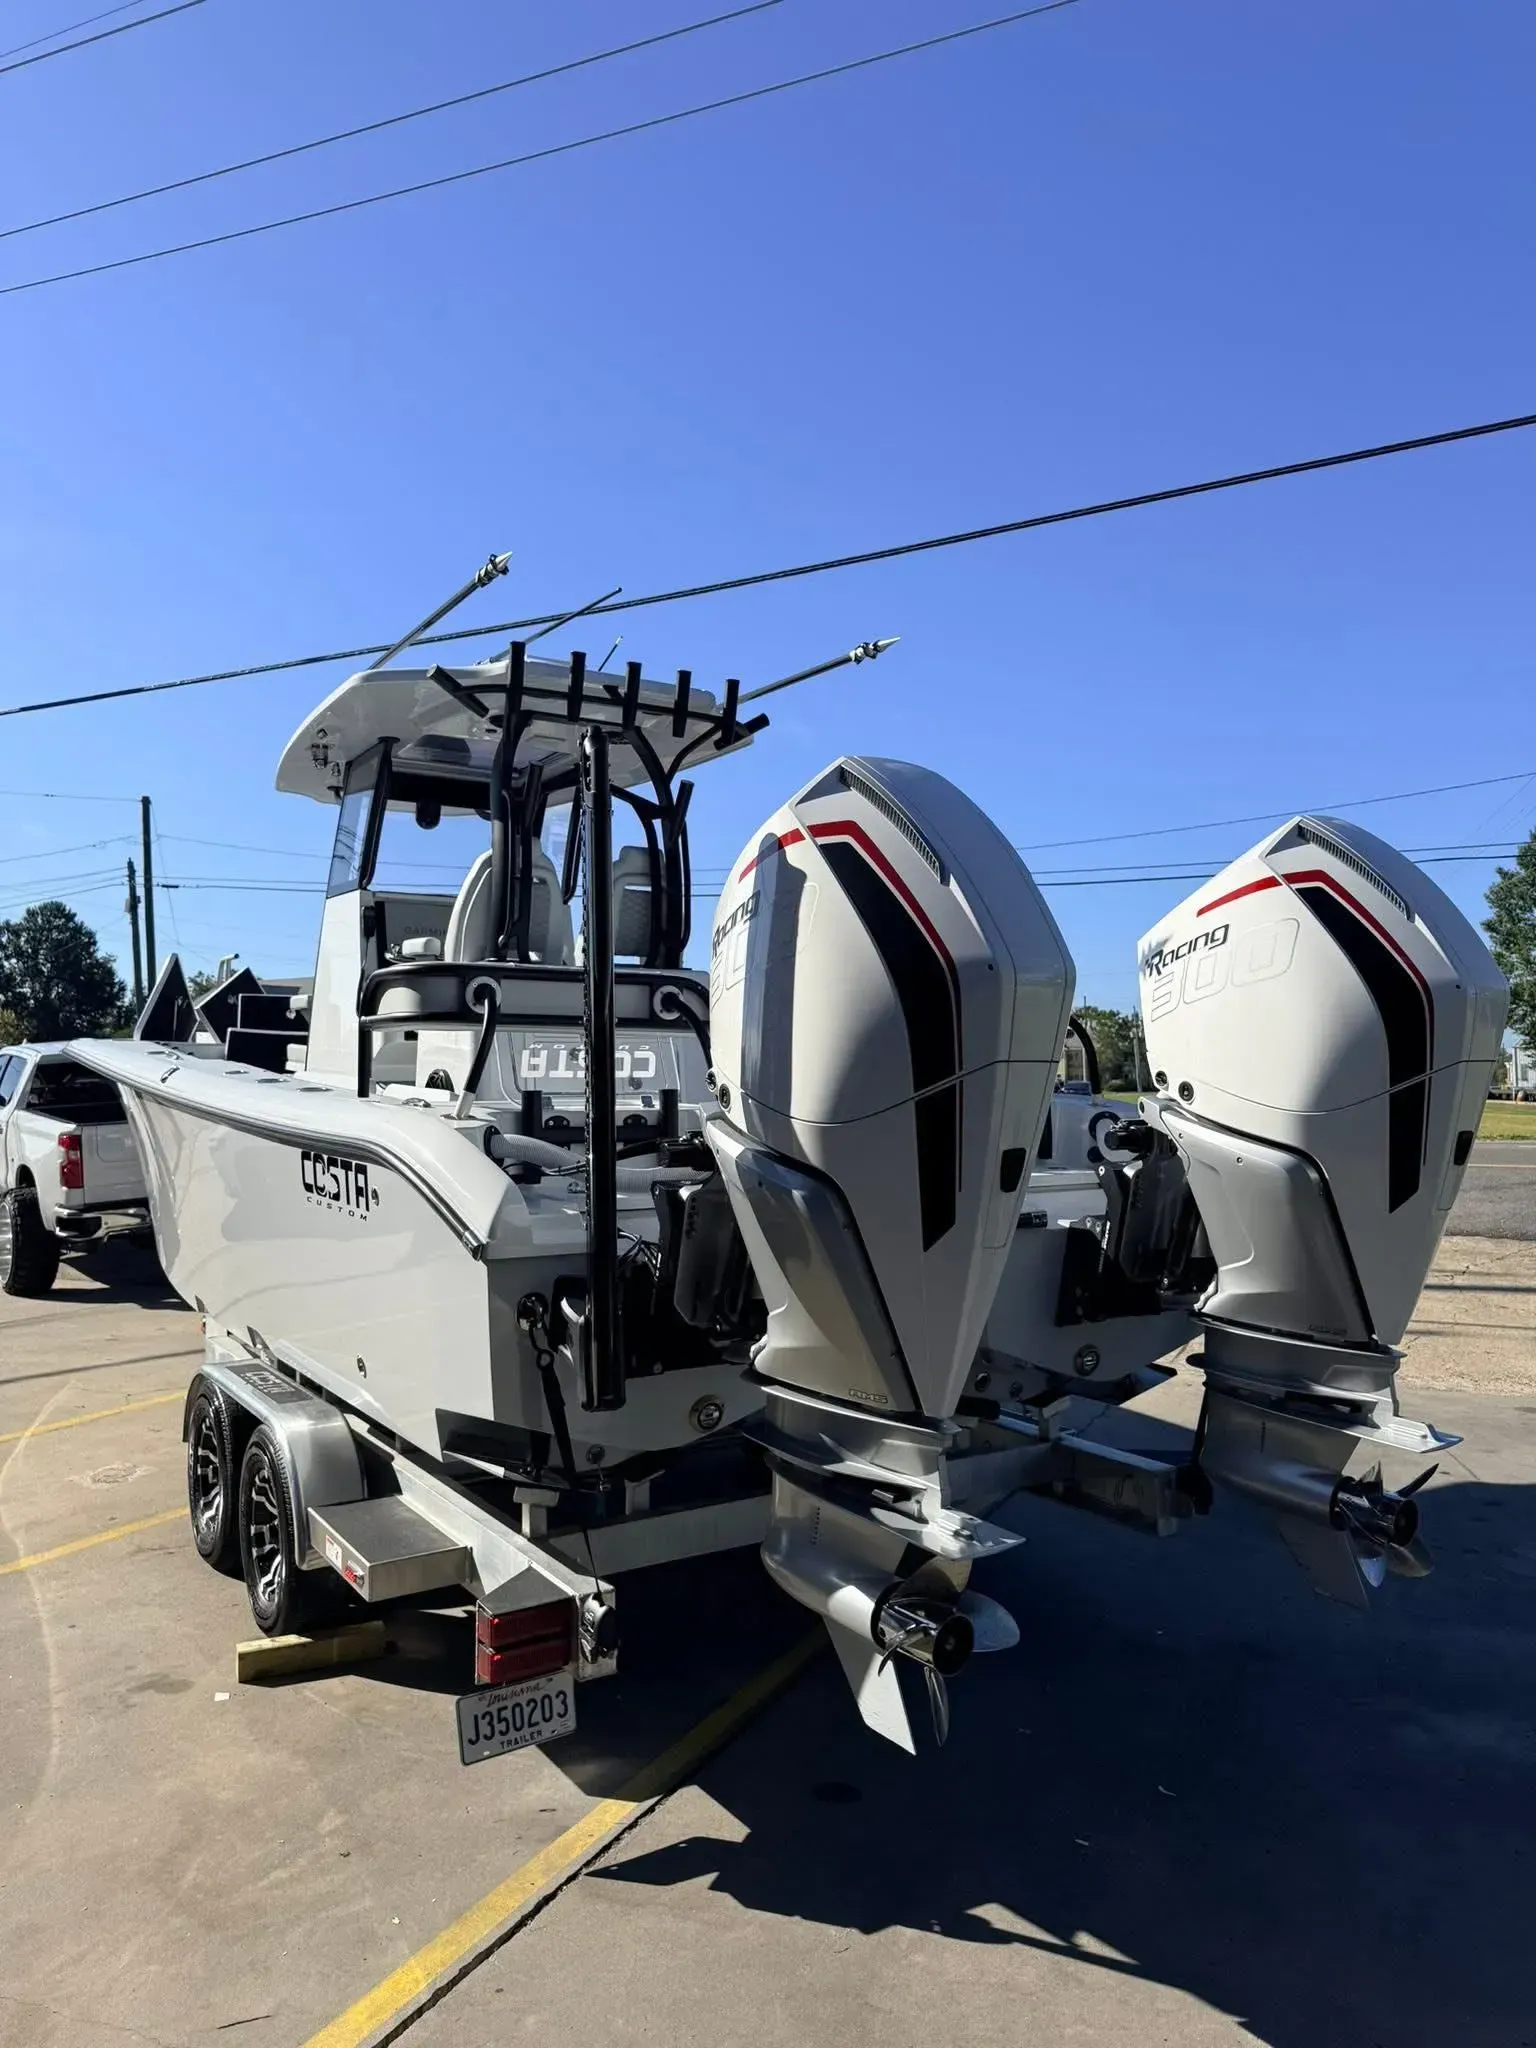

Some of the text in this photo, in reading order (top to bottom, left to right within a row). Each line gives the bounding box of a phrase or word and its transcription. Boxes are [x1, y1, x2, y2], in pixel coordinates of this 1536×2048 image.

[1146, 923, 1230, 979] Racing
[1151, 917, 1300, 1023] 300
[301, 1151, 370, 1212] COSTA
[306, 1196, 368, 1222] CUSTOM
[467, 1689, 569, 1746] J350203
[500, 1730, 543, 1750] TRAILER
